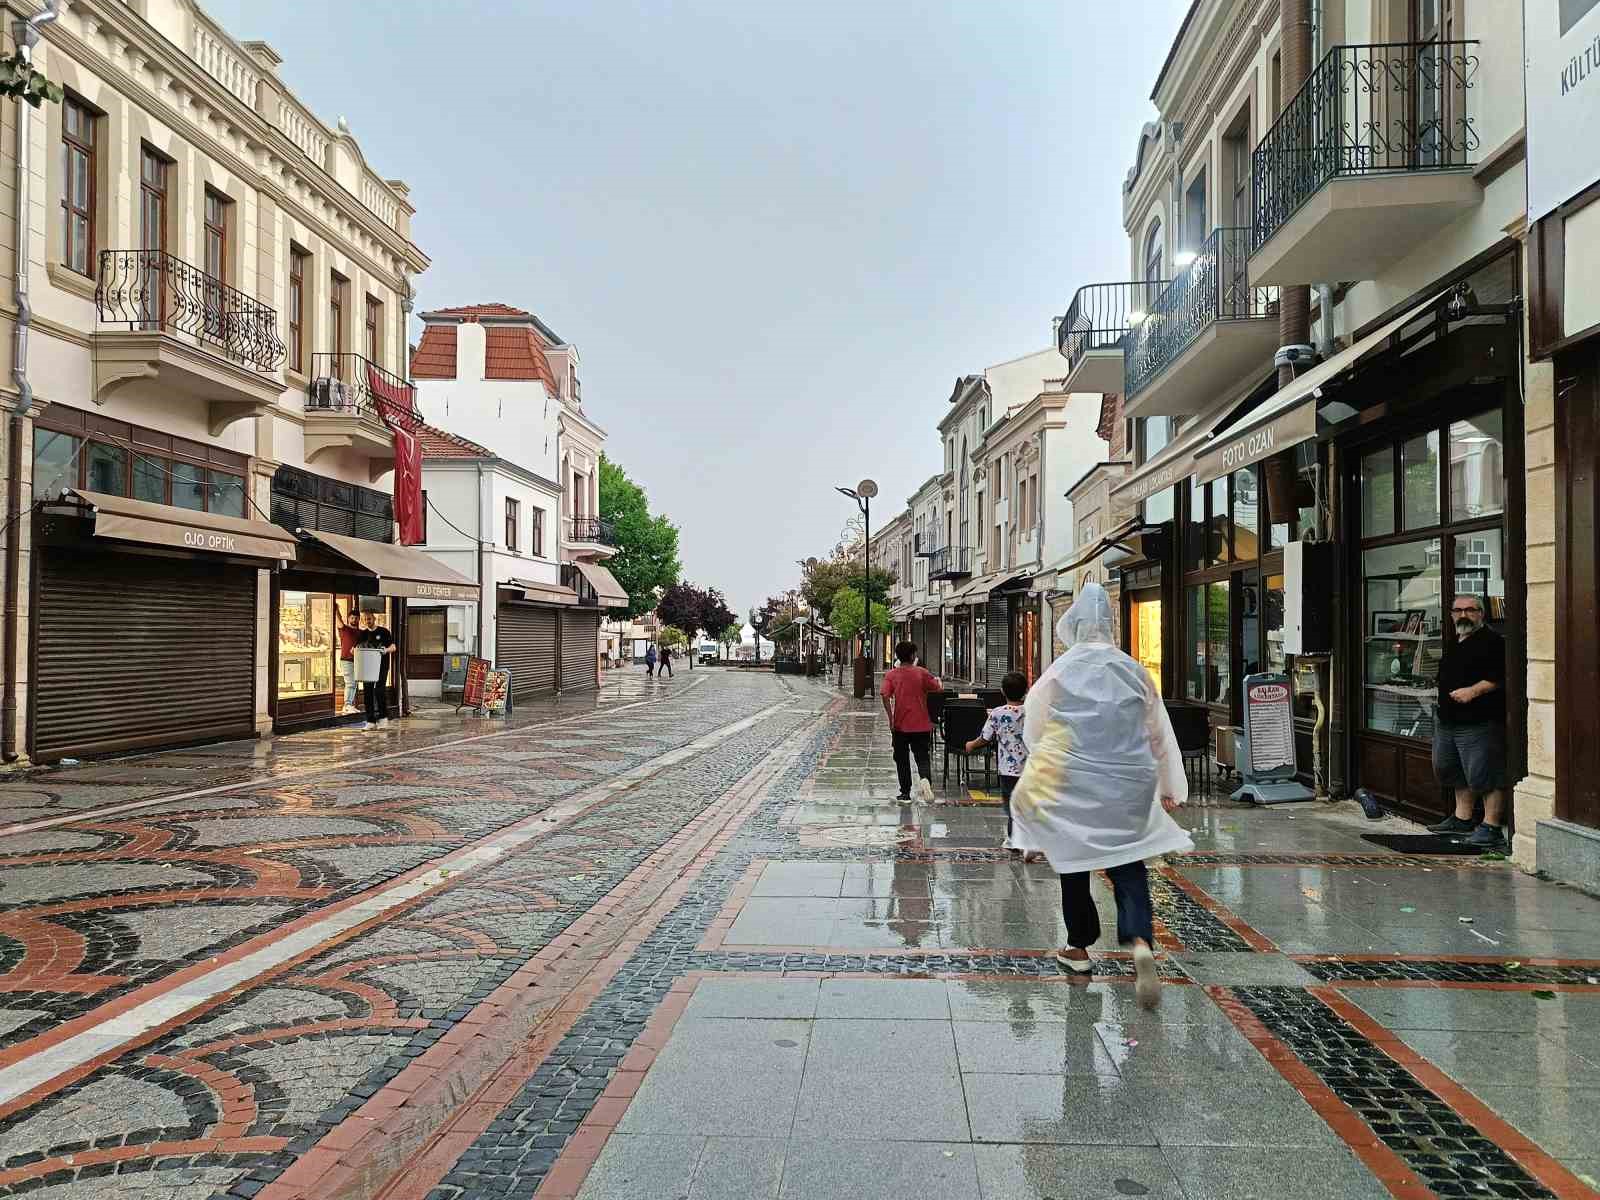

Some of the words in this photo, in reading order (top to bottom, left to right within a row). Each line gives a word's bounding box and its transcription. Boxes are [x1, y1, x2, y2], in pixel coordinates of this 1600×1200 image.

[1222, 442, 1245, 469] FOTO
[1248, 427, 1274, 456] OZAN
[184, 532, 204, 546] OJO
